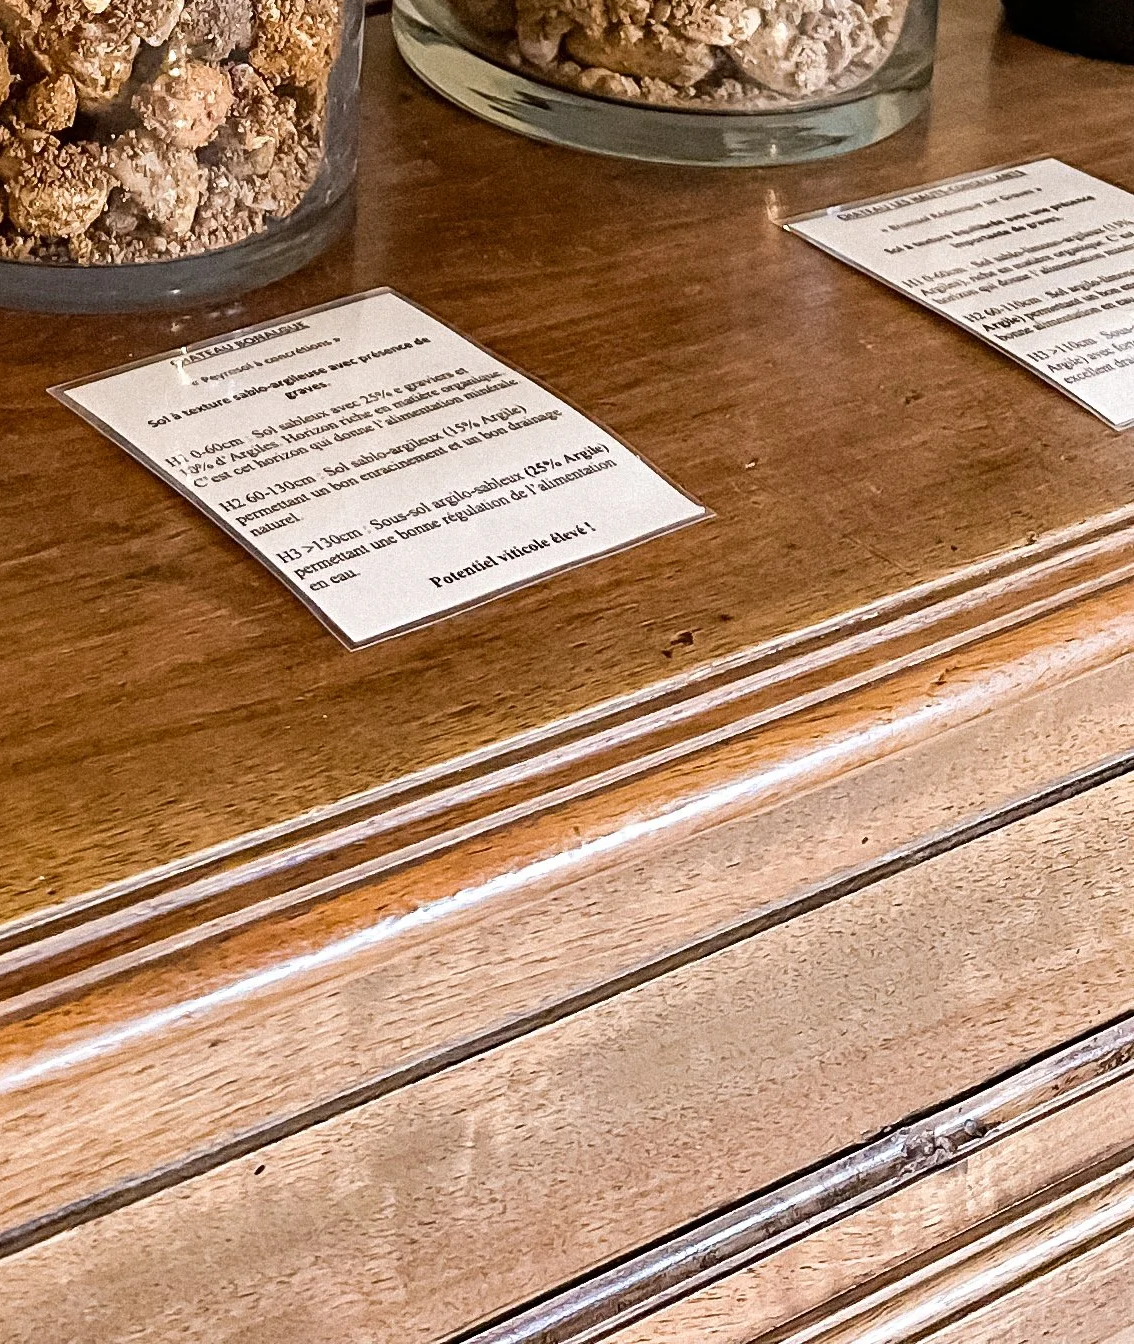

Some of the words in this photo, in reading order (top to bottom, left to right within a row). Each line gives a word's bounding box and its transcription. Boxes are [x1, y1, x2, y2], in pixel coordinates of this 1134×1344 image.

[147, 416, 171, 428] Sol
[181, 398, 232, 416] texture
[233, 368, 328, 401] sablo-argileuse
[328, 359, 358, 371] avec
[358, 343, 413, 363] présence
[251, 426, 278, 438] Sol
[278, 411, 330, 430] sableux
[330, 401, 361, 414] avec
[359, 390, 393, 404] 25%
[404, 372, 455, 392] graviers
[281, 422, 339, 444] Horizon
[339, 411, 373, 426] riche
[374, 406, 392, 414] en
[392, 390, 440, 409] matière
[218, 498, 246, 512] H2
[246, 476, 317, 503] 60-130cm
[323, 462, 350, 476] Sol
[351, 433, 444, 468] sablo-argileux
[442, 420, 480, 437] (15%
[481, 405, 527, 425] Argile)
[233, 463, 256, 475] cet
[252, 447, 309, 468] horizon
[309, 439, 333, 451] qui
[333, 425, 375, 442] donne
[235, 494, 311, 526] permettant
[310, 488, 331, 498] un
[327, 478, 359, 491] bon
[359, 446, 448, 481] enracinement
[448, 442, 463, 451] et
[462, 436, 482, 446] un
[478, 428, 508, 439] bon
[508, 410, 562, 431] drainage
[276, 548, 302, 563] H3
[302, 530, 363, 553] >130cm
[369, 502, 432, 530] Sous-sol
[431, 473, 525, 509] argilo-sableux
[524, 459, 562, 478] (25%
[563, 444, 609, 464] Argile)
[294, 545, 370, 579] permettant
[370, 536, 398, 550] une
[394, 520, 441, 540] bonne
[442, 497, 511, 525] régulation
[510, 490, 528, 501] de
[309, 580, 330, 591] en
[429, 556, 499, 588] Potentiel
[497, 539, 550, 562] viticole
[550, 525, 587, 543] élevé
